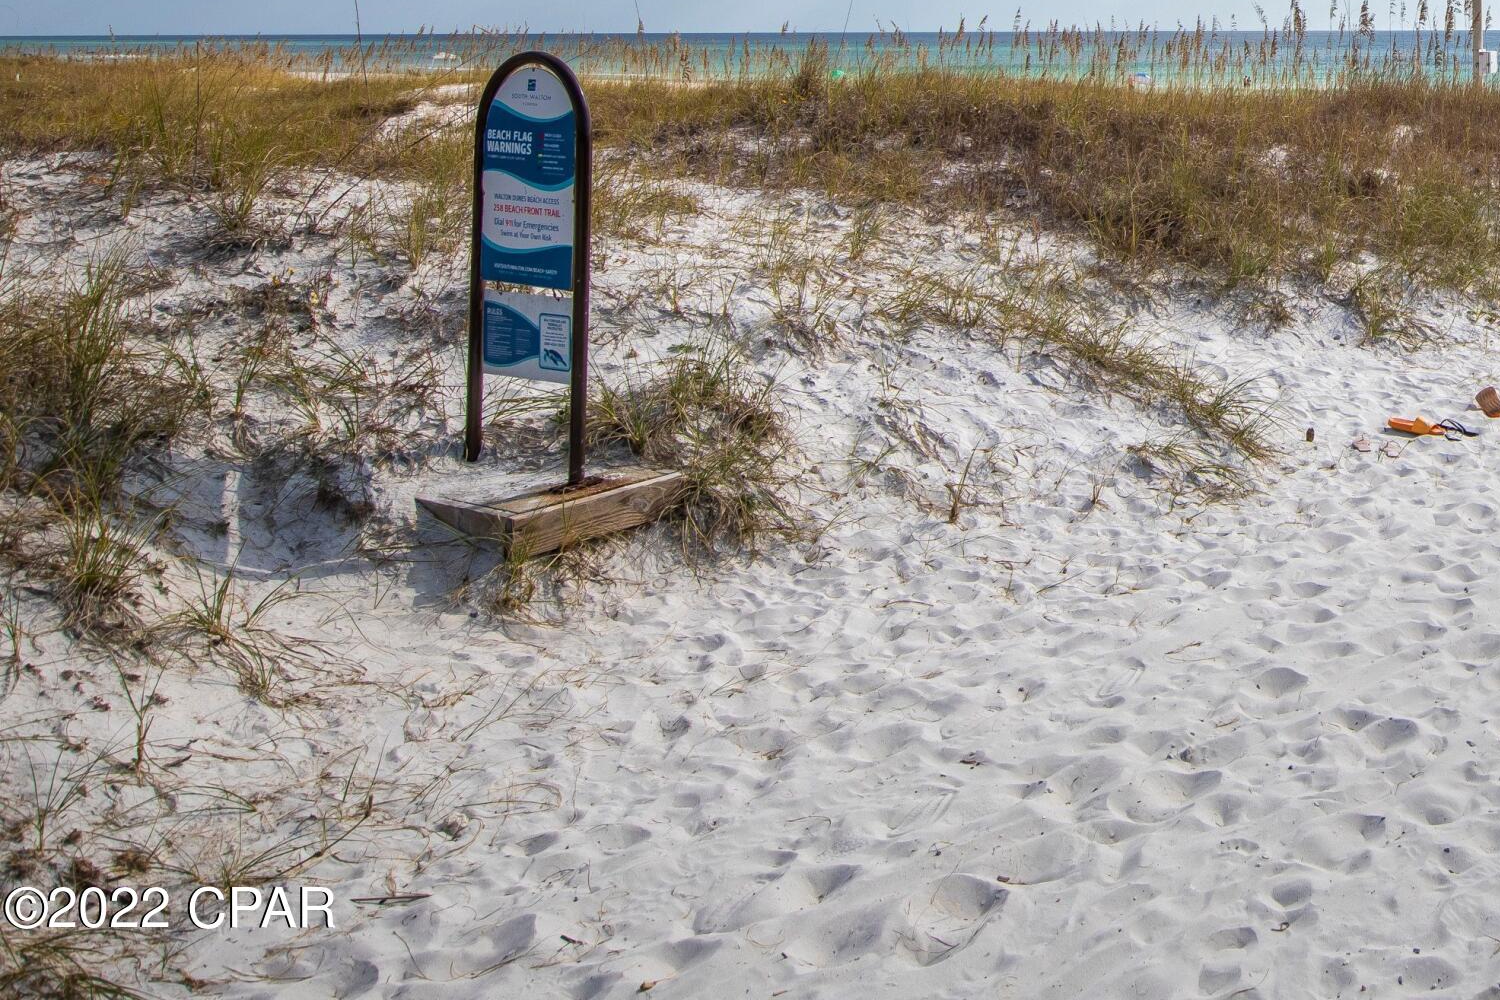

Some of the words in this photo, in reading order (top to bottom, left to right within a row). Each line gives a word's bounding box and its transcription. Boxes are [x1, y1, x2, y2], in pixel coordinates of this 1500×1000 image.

[487, 129, 511, 140] BEACH
[513, 131, 532, 142] FLAG
[487, 141, 532, 155] WARNINGS
[542, 197, 560, 205] ACCESS
[505, 204, 523, 213] BEACH
[524, 206, 543, 216] FRONT
[544, 208, 560, 217] TRAIL
[513, 219, 522, 227] for
[523, 221, 559, 232] Emergencies
